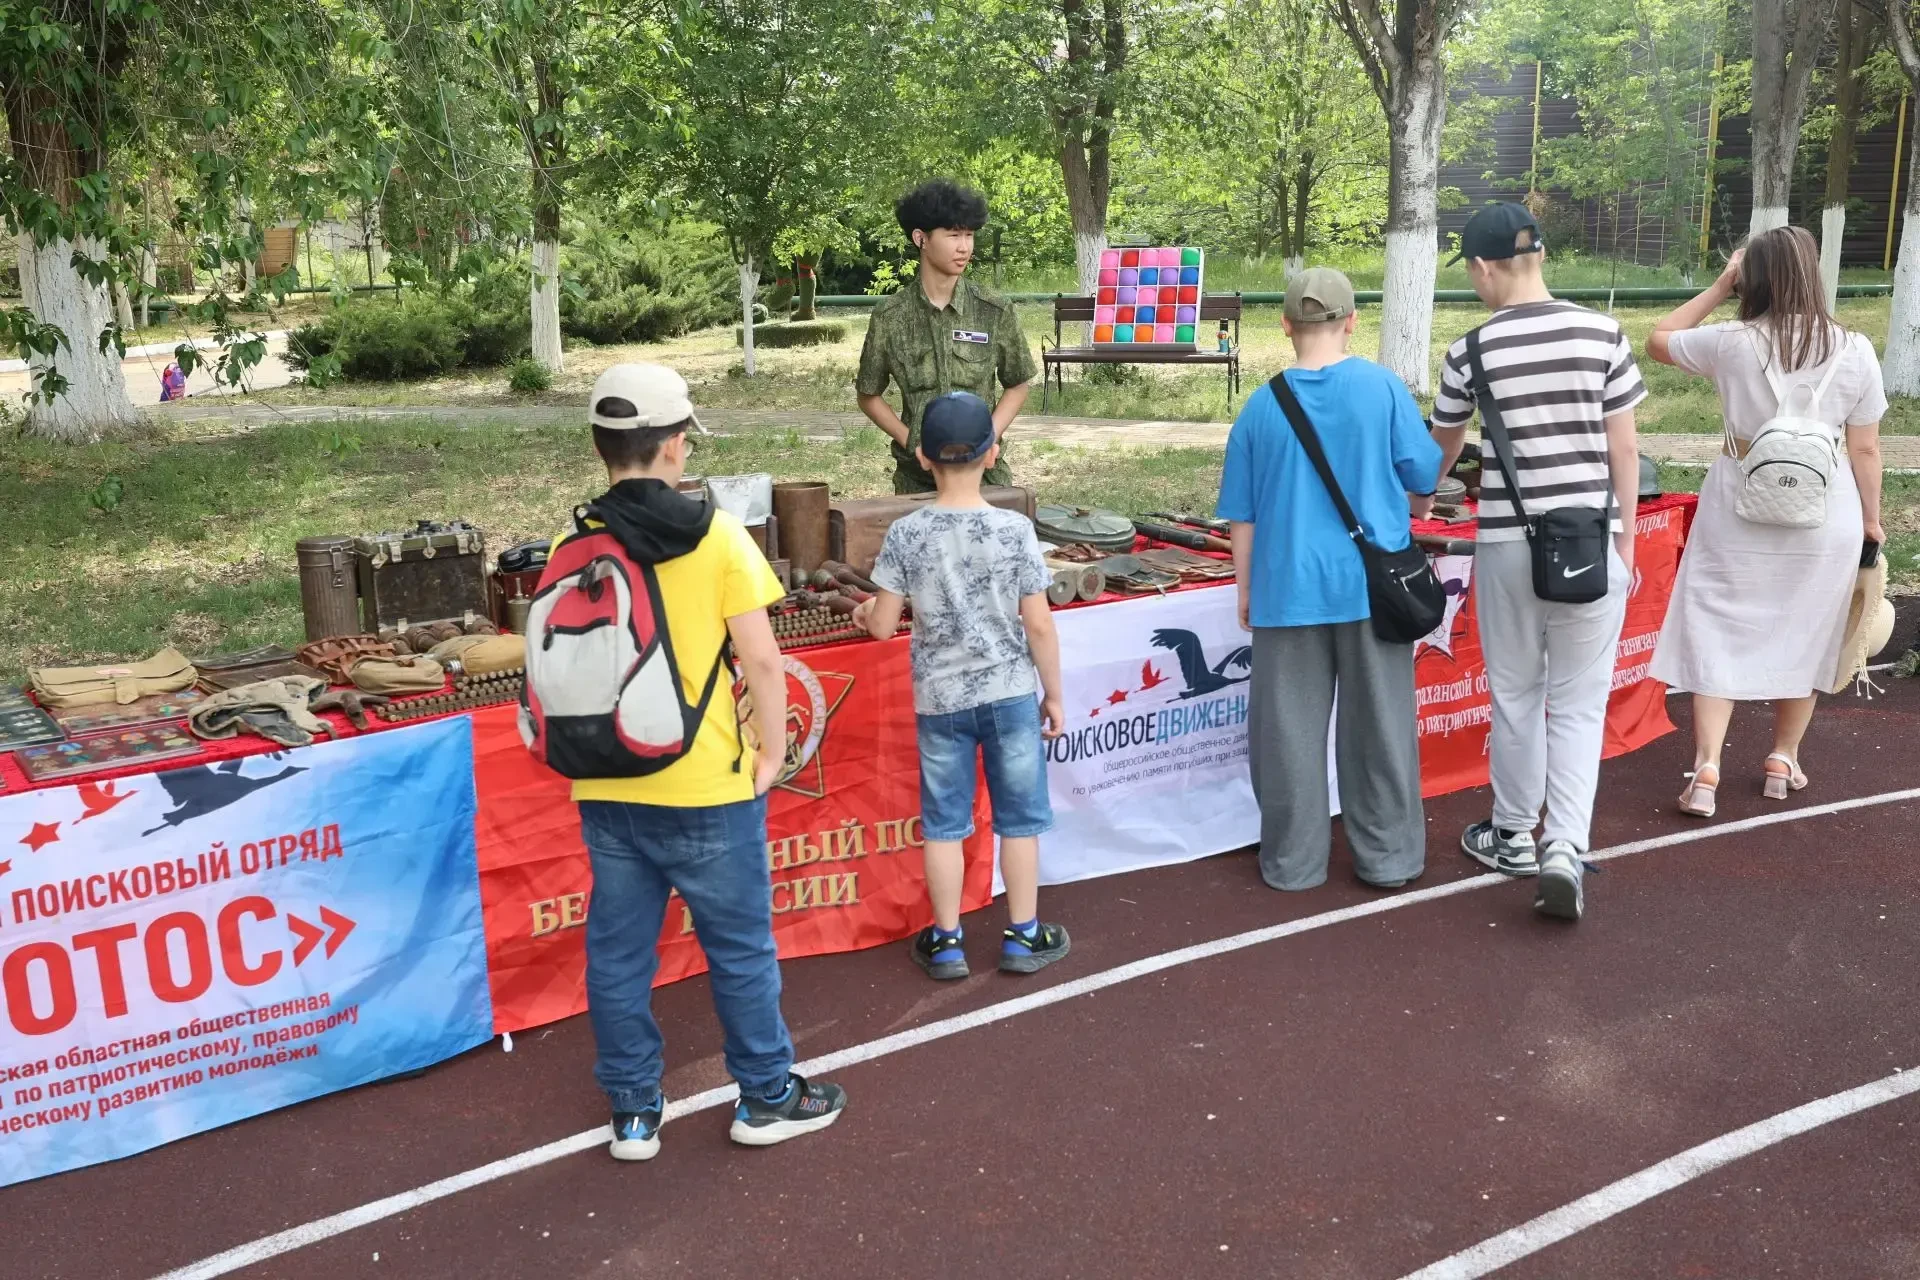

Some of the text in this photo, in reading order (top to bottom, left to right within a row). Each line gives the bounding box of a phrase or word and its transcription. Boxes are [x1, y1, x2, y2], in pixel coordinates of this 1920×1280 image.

[1072, 785, 1086, 795] по
[1088, 771, 1140, 797] увековечению
[1142, 763, 1172, 779] памяти
[1173, 754, 1213, 771] погибших
[1215, 751, 1231, 766] при
[1172, 738, 1232, 757] общественное
[11, 823, 344, 924] ПОИСКОВЫЙ ОТРЯД
[14, 1004, 359, 1106] по патриотическому, правовому
[55, 1030, 171, 1071] областная
[177, 992, 331, 1040] общественная
[98, 1069, 203, 1118] развитию
[209, 1043, 319, 1080] молодёжи
